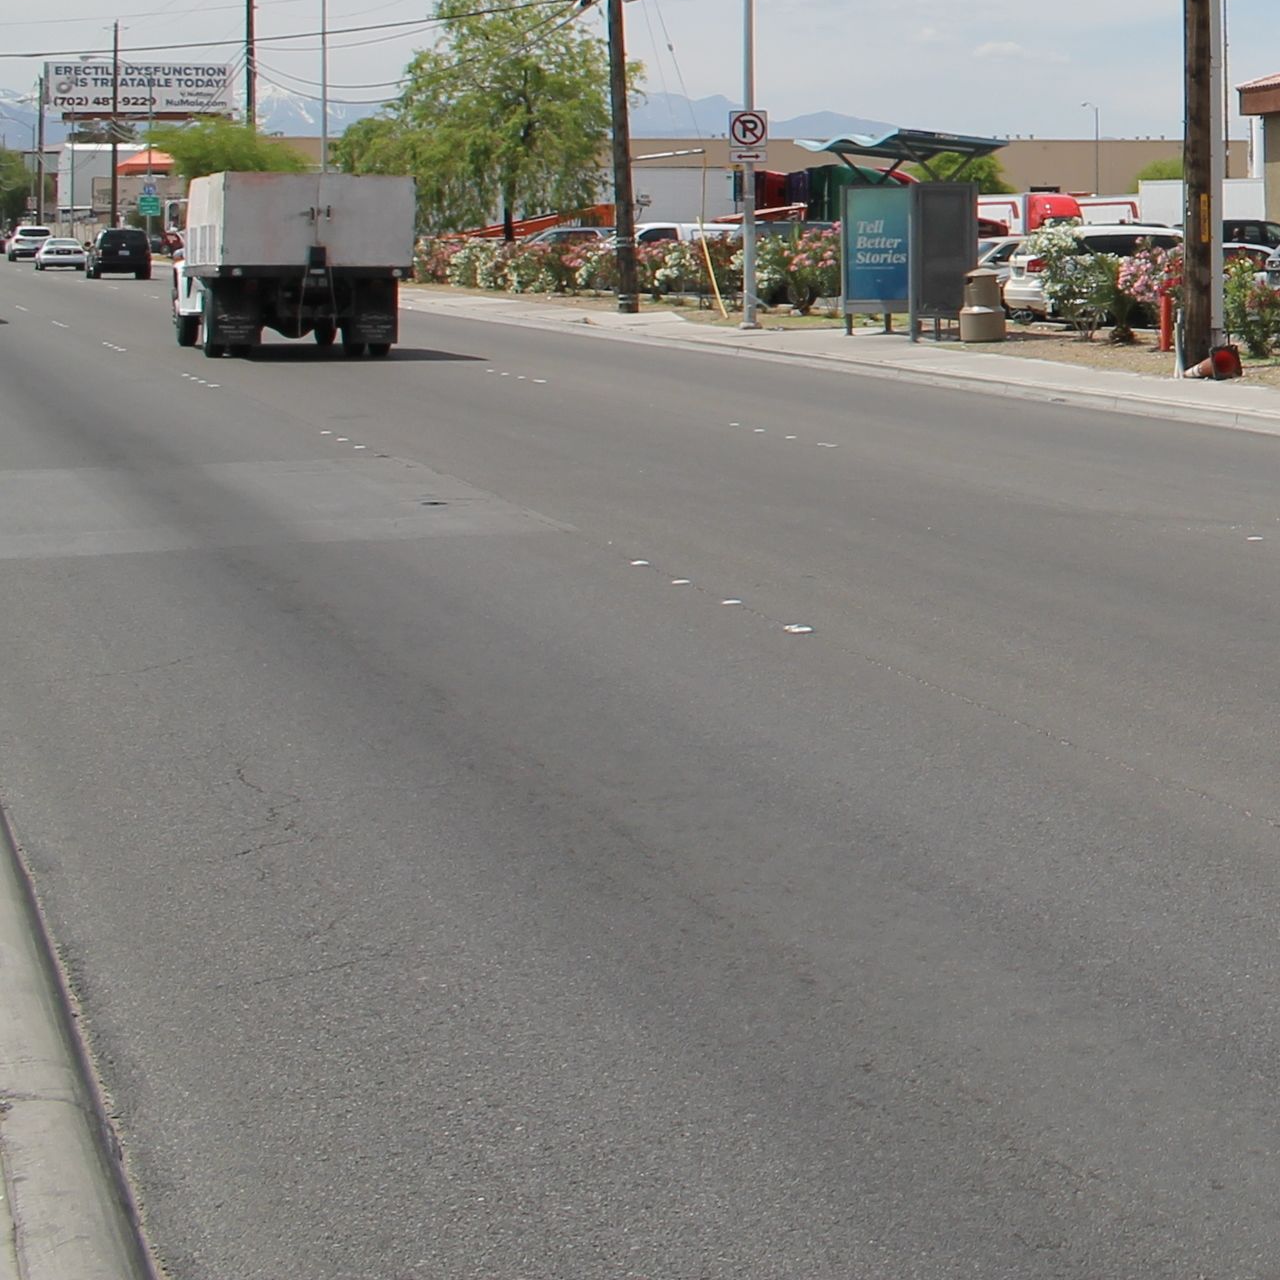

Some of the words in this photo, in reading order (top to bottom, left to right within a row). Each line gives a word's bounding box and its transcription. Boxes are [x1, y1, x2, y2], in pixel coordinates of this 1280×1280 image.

[125, 66, 226, 76] DYSFUNCTION
[75, 77, 88, 87] IS
[54, 96, 88, 106] (702)
[857, 220, 884, 234] Tell
[856, 235, 902, 249] Better
[856, 250, 908, 264] Stories
